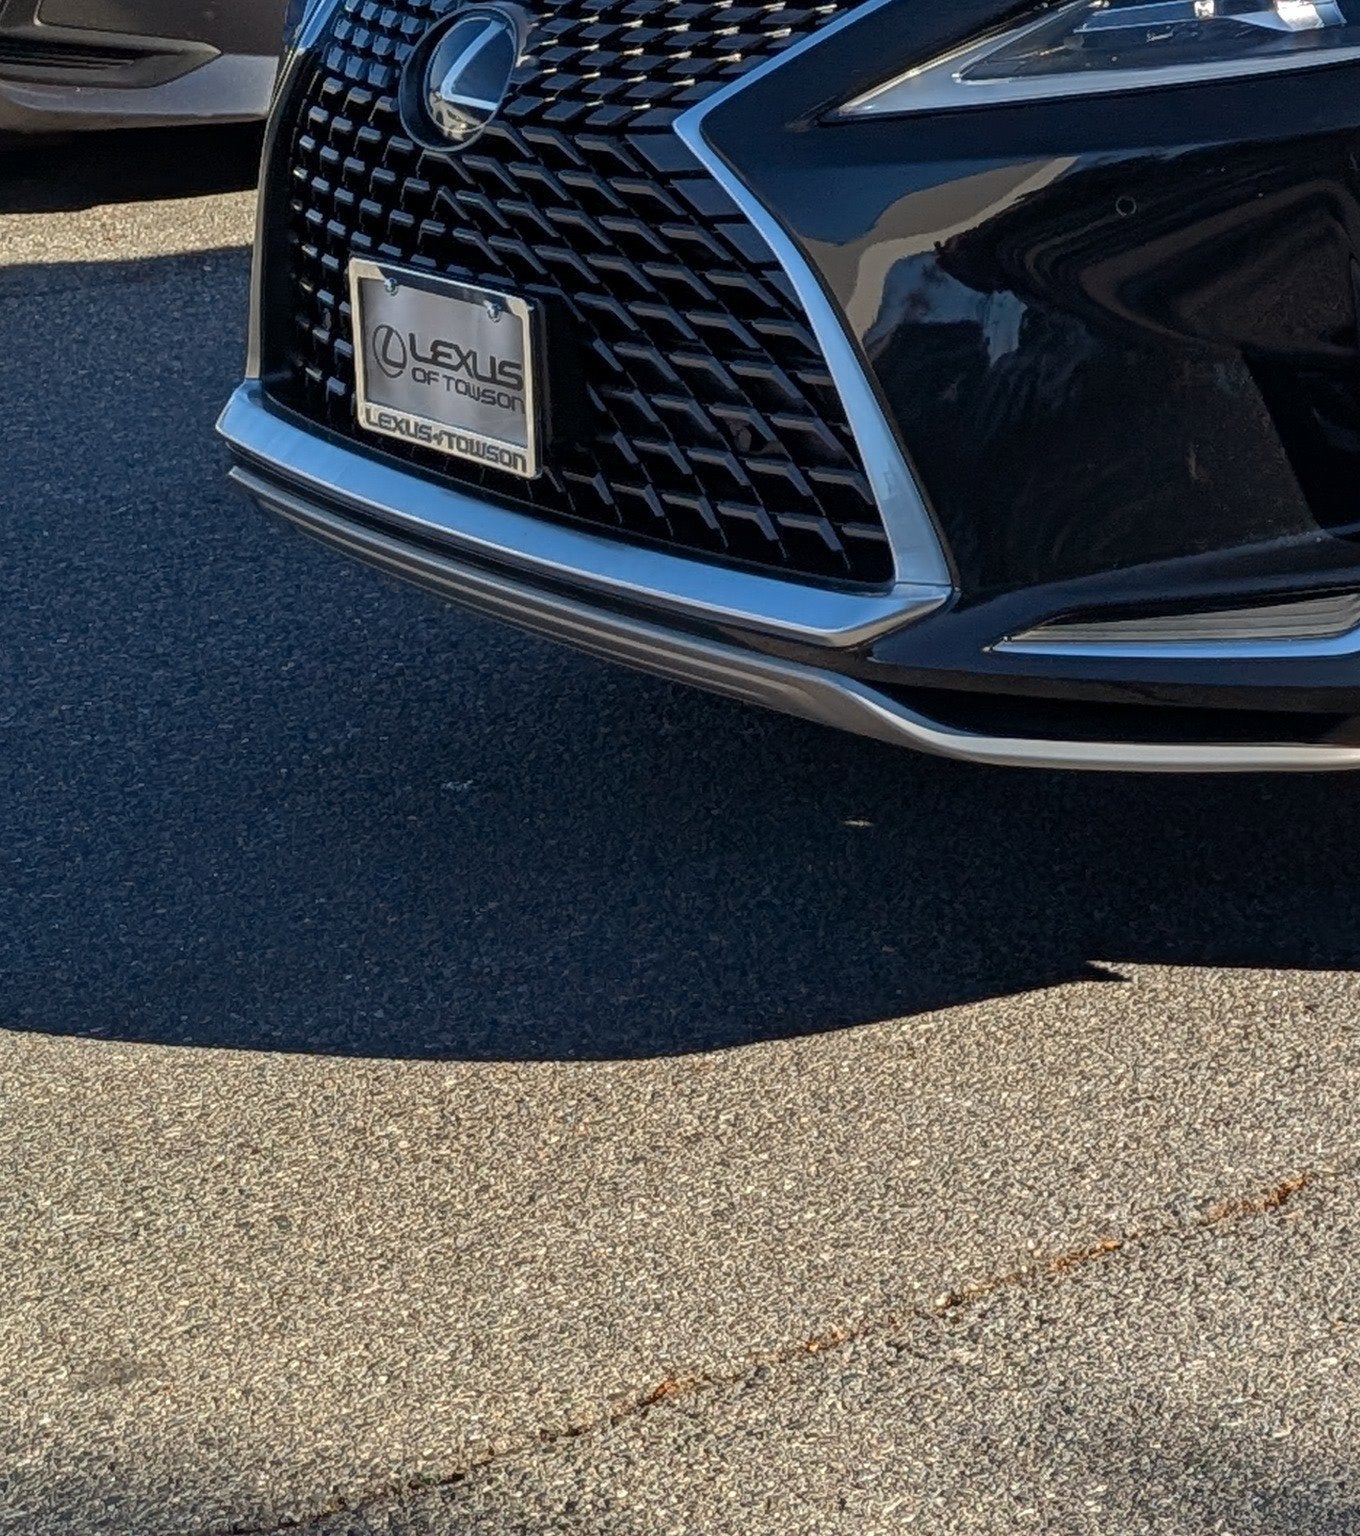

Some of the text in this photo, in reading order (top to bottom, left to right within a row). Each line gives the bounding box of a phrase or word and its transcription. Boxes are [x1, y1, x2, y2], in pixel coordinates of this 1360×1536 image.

[409, 332, 524, 392] LEXUS
[410, 366, 525, 412] OF TOWSON
[364, 406, 433, 444] LEXUS
[445, 431, 528, 474] TOWSON
